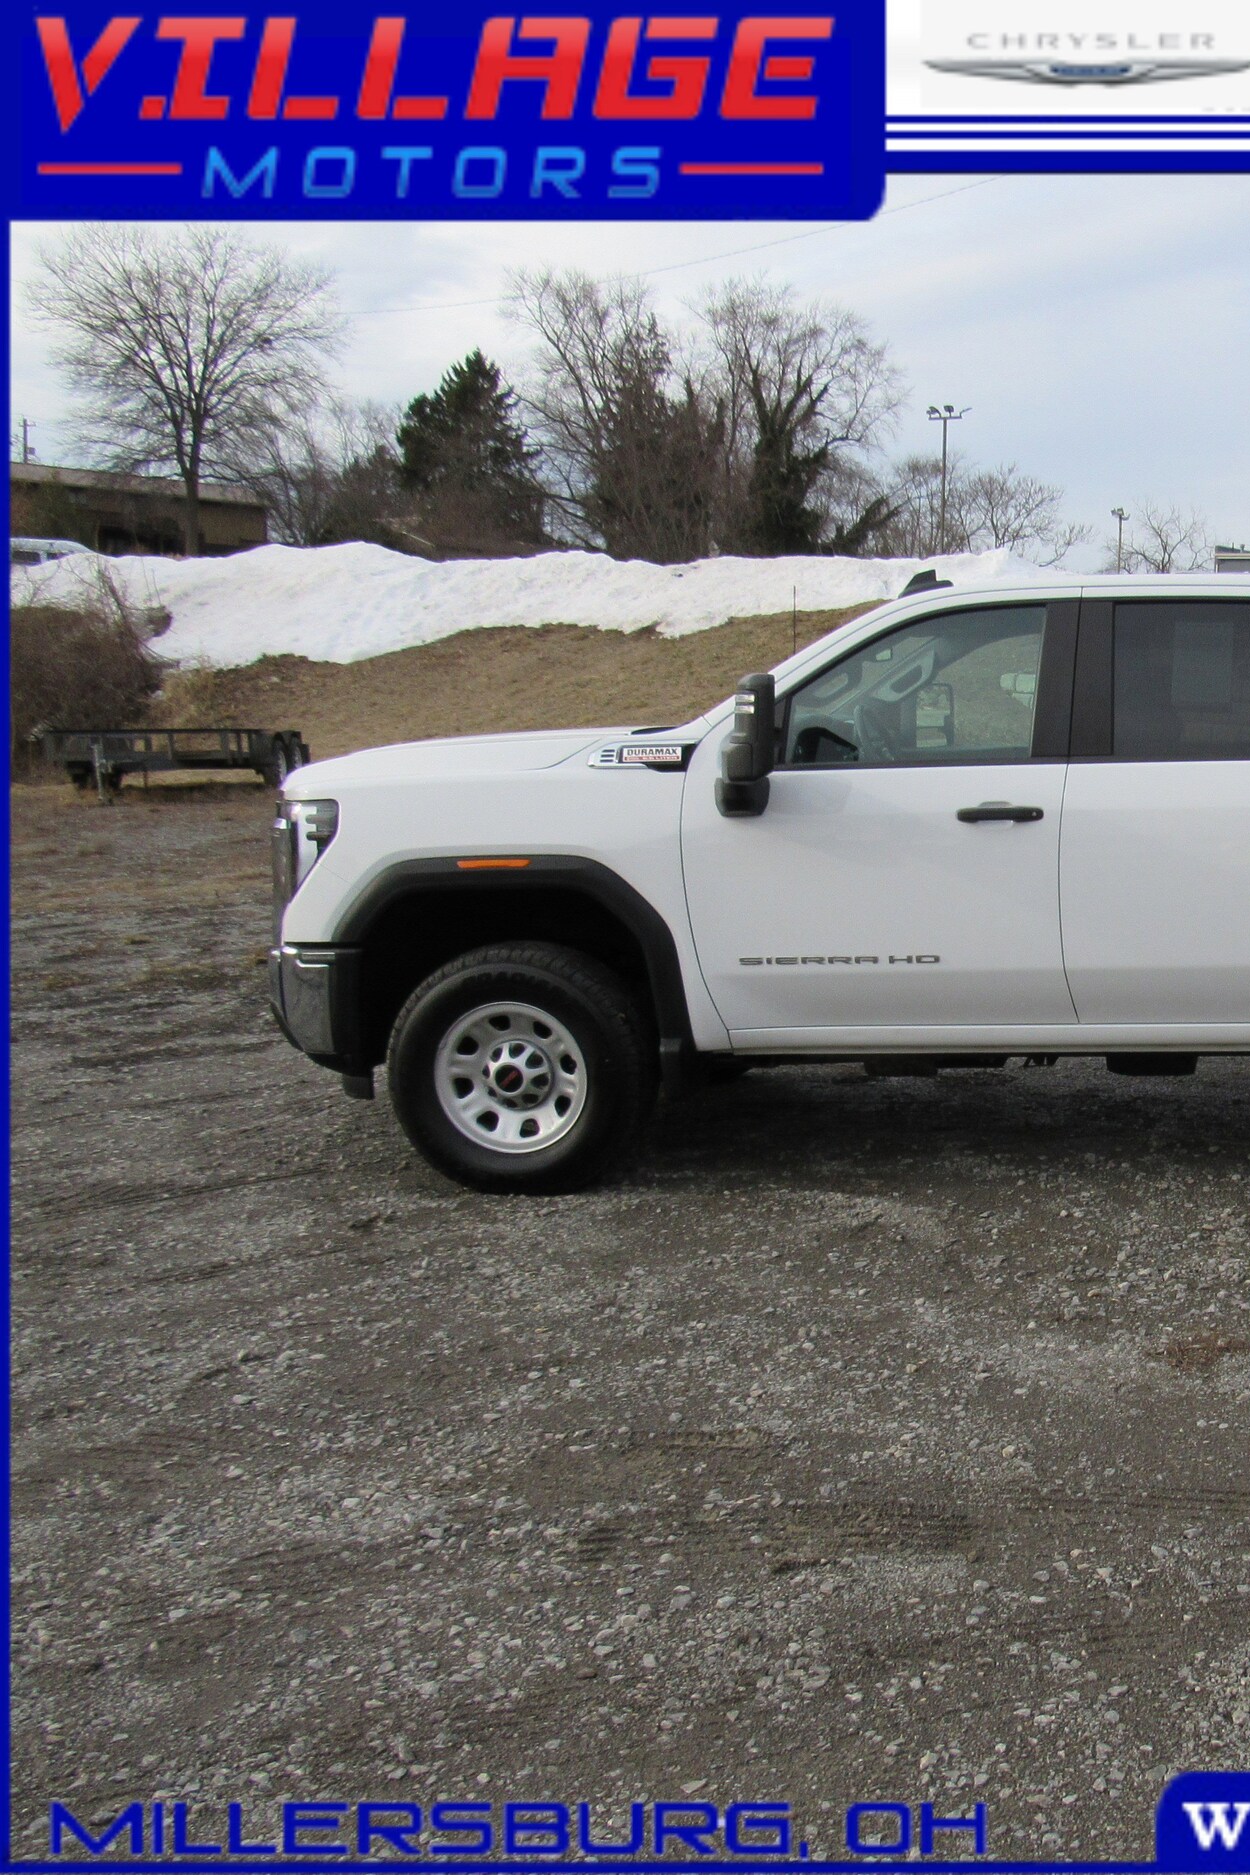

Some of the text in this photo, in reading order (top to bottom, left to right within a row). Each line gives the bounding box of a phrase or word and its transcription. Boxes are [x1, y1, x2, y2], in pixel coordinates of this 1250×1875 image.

[626, 747, 678, 756] DURAMAX
[739, 955, 940, 966] SIERRA HD
